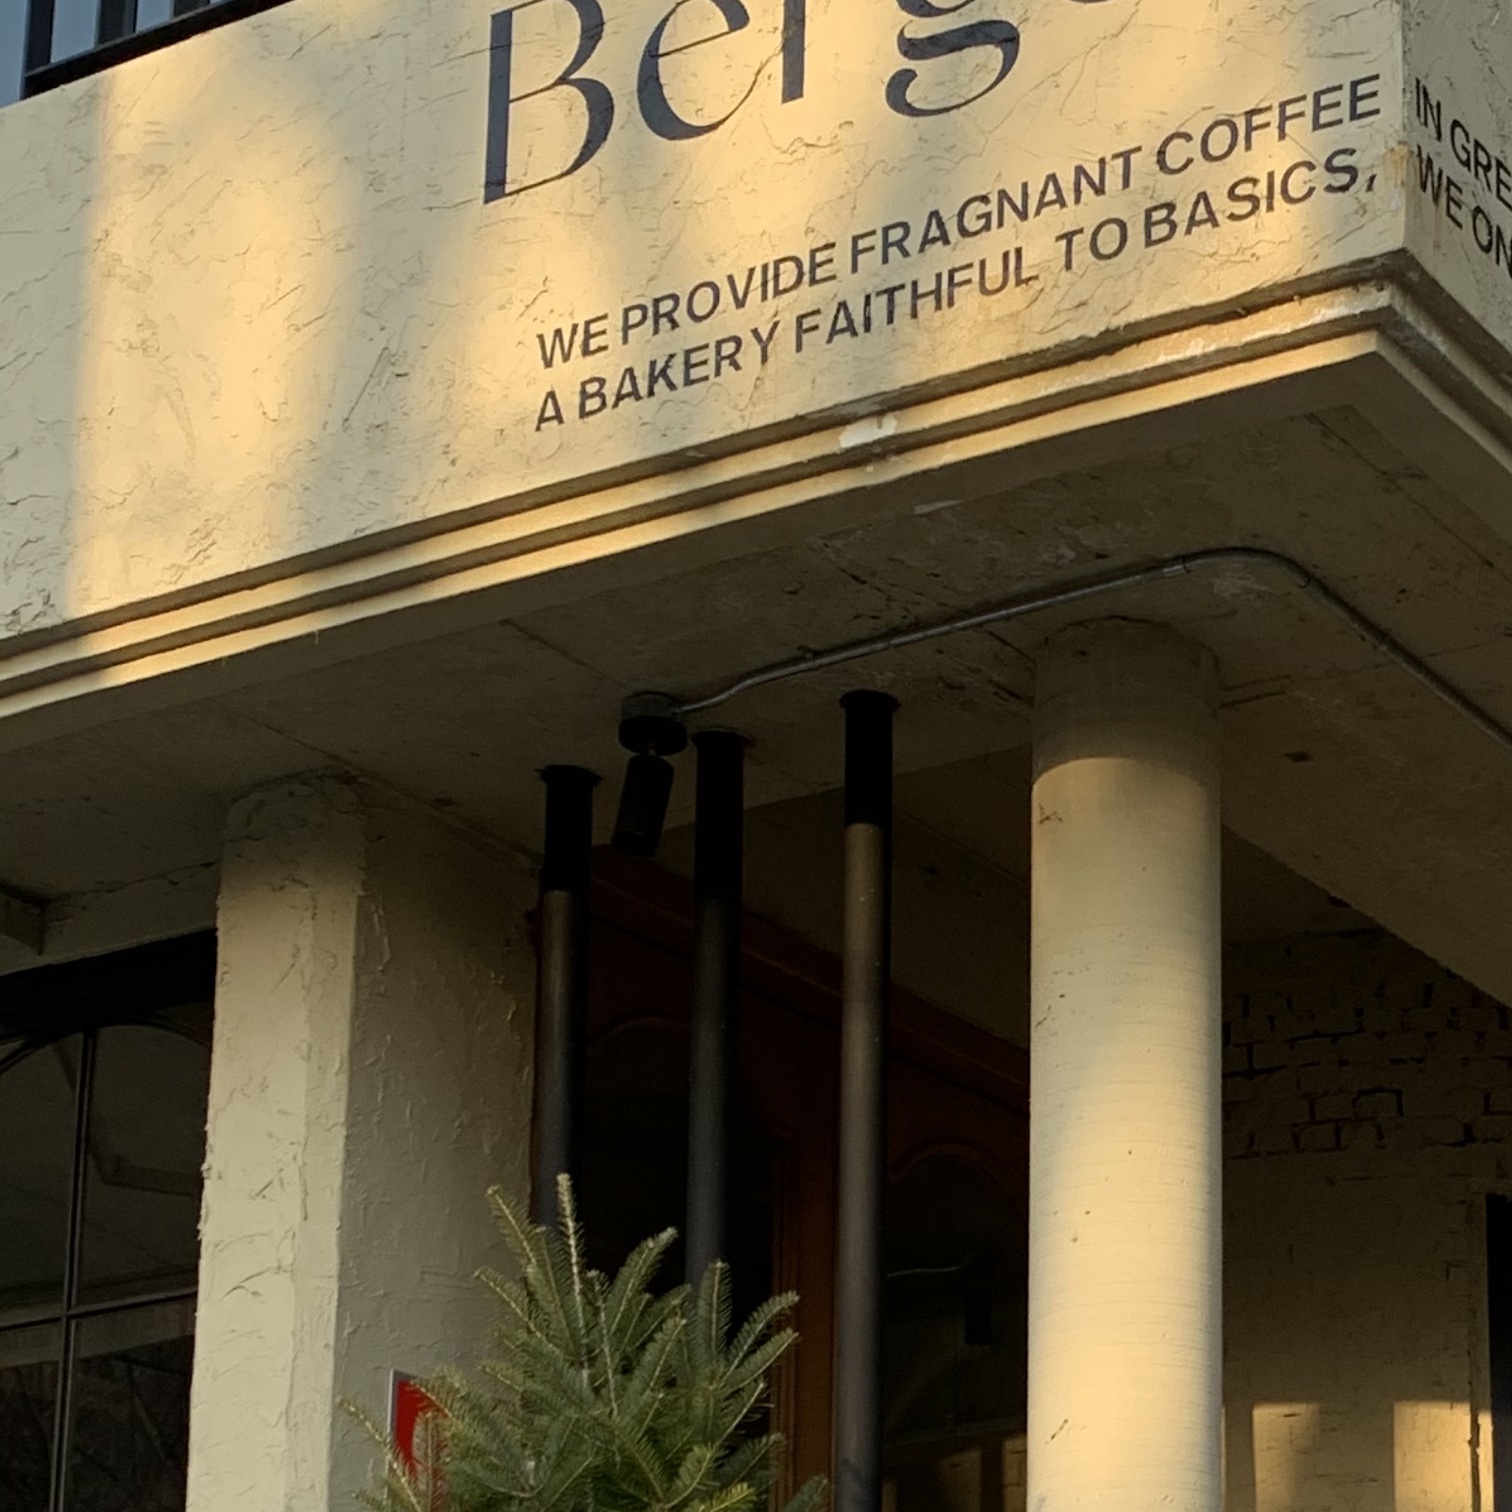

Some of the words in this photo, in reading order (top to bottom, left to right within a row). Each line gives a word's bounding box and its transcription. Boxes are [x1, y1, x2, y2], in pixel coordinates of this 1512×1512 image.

[483, 0, 1108, 205] Berg
[1416, 77, 1442, 142] IN
[1416, 144, 1463, 230] WE
[535, 390, 565, 432] A
[578, 320, 780, 420] BAKERY
[795, 246, 1039, 353] FAITHFUL
[1055, 217, 1128, 271] TO
[1144, 148, 1377, 248] BASICS,
[536, 314, 609, 369] WE
[621, 242, 837, 345] PROVIDE
[851, 145, 1142, 274] FRAGNANT
[1156, 73, 1381, 175] COFFEE
